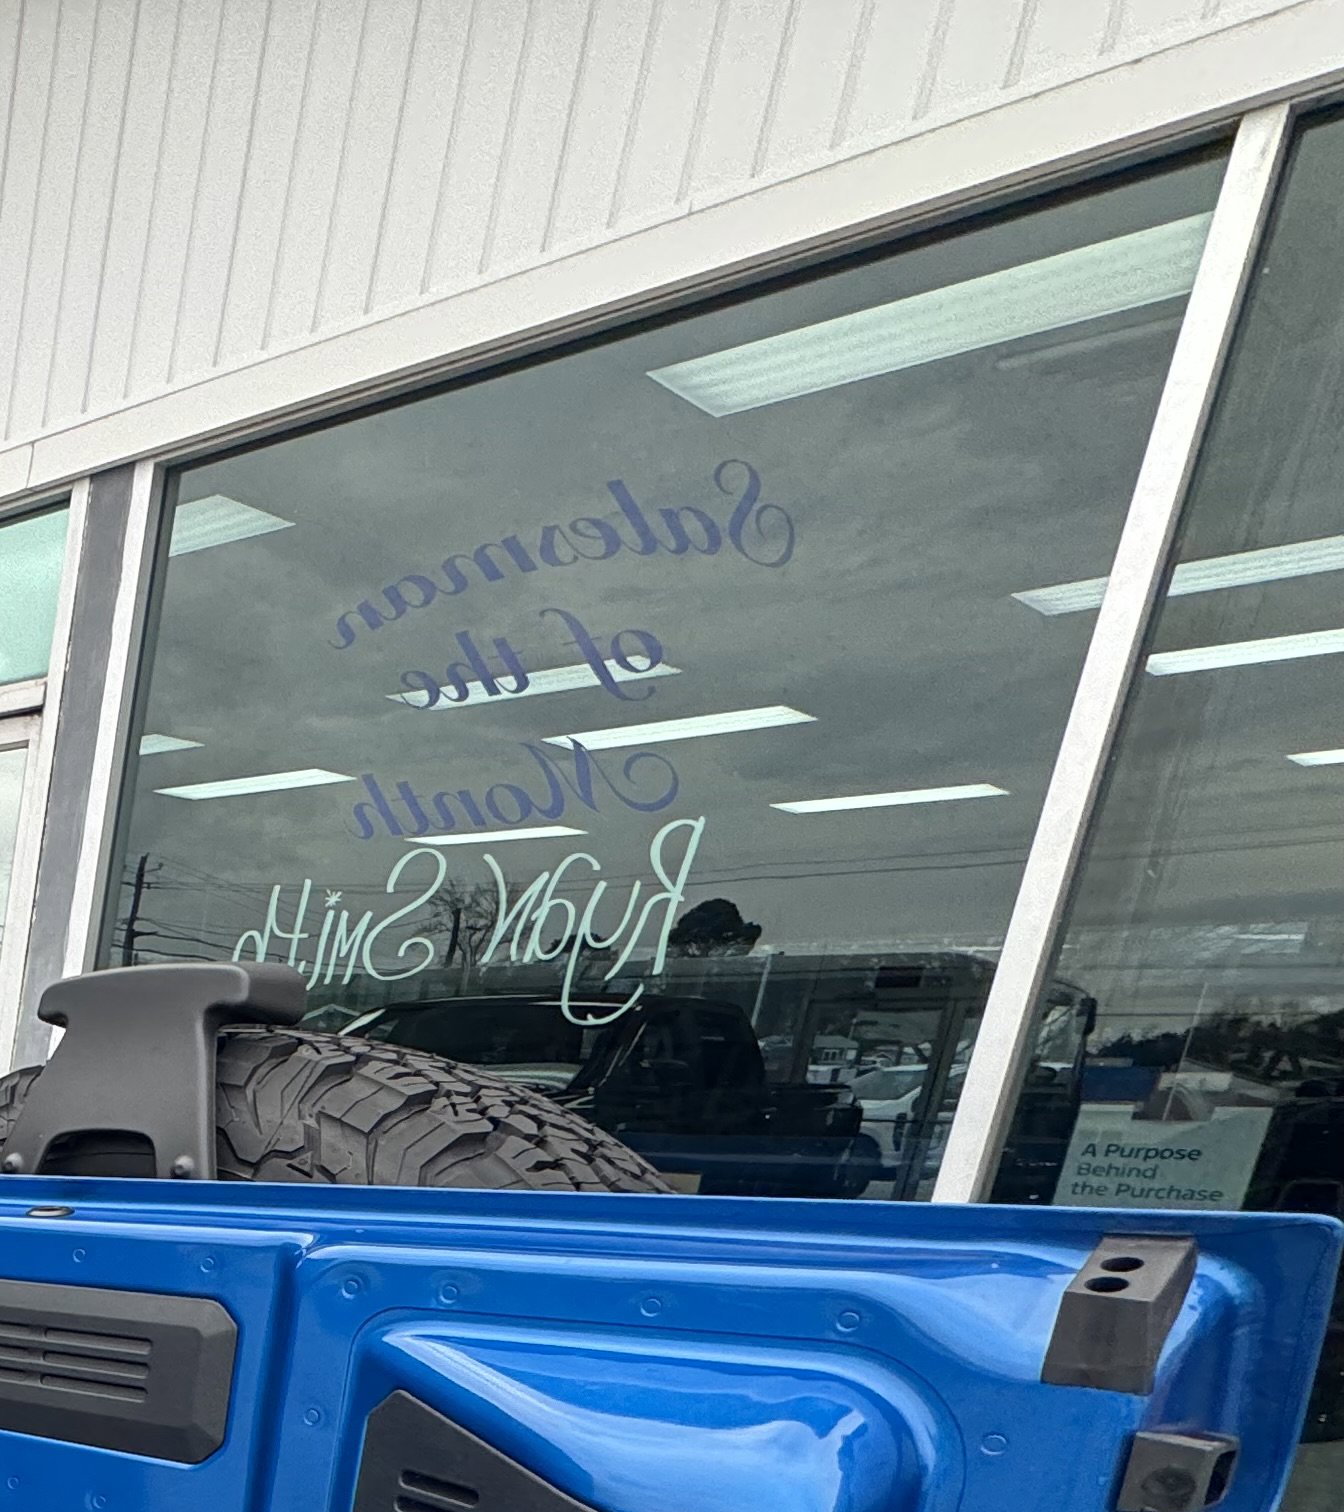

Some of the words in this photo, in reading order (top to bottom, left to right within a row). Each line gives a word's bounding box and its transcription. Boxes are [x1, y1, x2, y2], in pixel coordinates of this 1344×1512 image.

[1080, 1143, 1097, 1158] A
[1104, 1143, 1202, 1162] Purpose
[1076, 1162, 1158, 1180] Behind
[1071, 1181, 1107, 1197] the
[1115, 1181, 1224, 1201] Purchase
